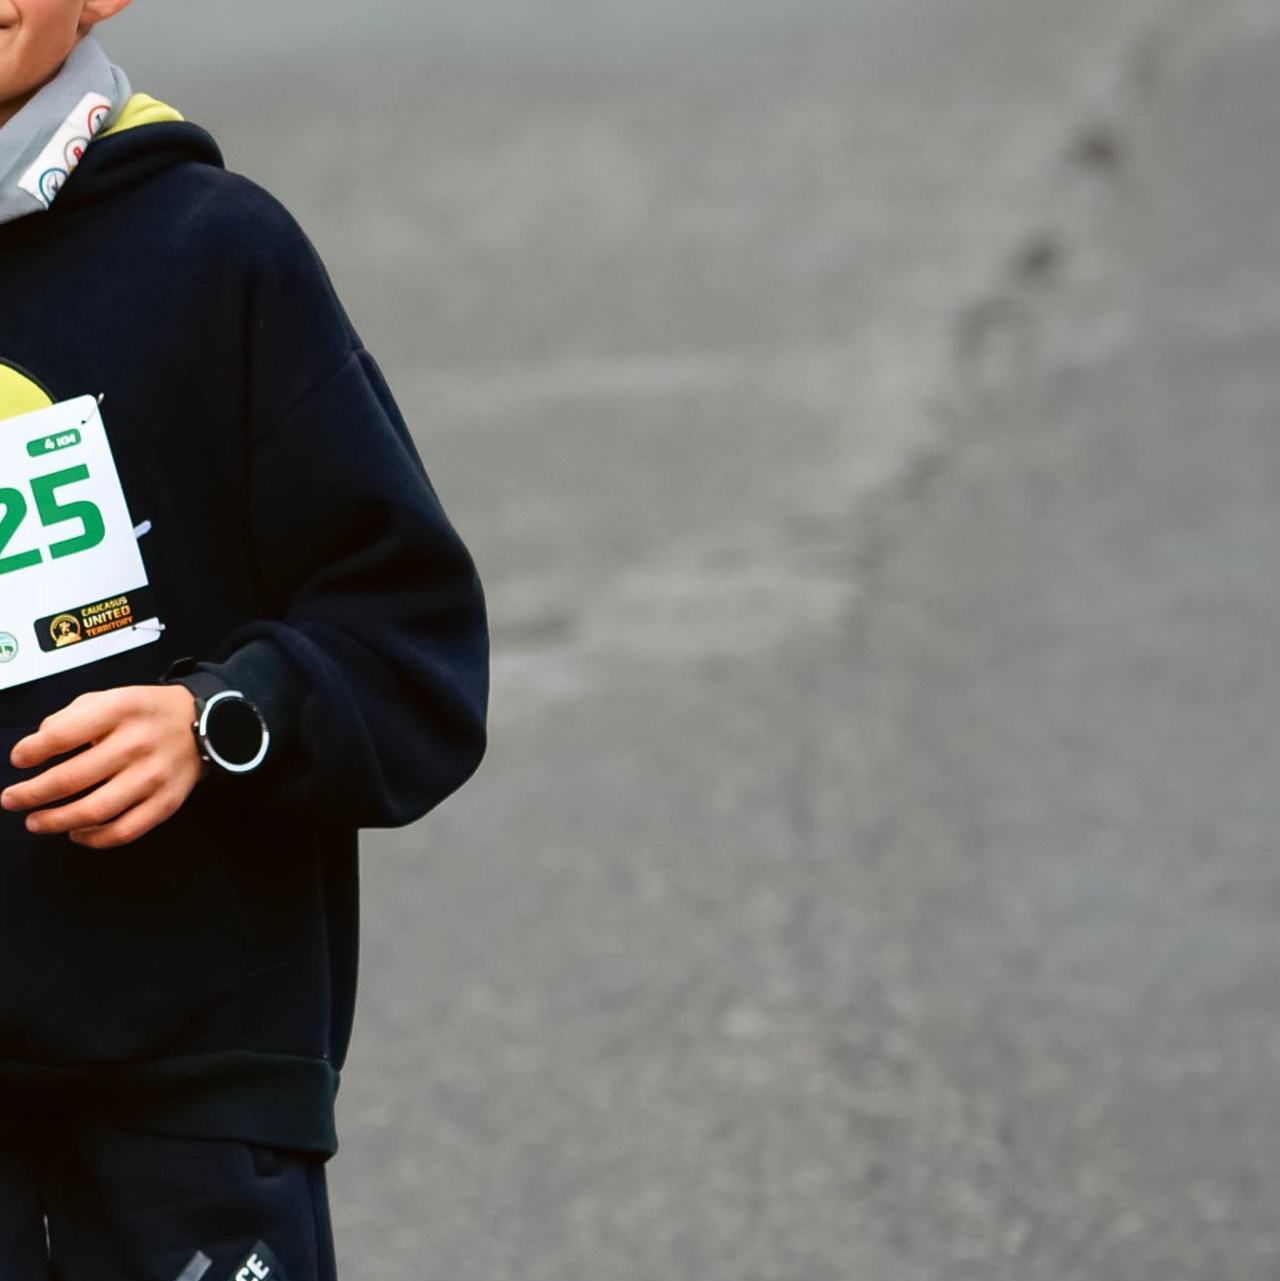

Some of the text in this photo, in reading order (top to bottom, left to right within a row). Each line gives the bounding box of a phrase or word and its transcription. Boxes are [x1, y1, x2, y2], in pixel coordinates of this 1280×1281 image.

[44, 437, 55, 450] 4
[80, 595, 128, 617] CAUCASUS
[82, 604, 131, 629] UNITED
[85, 615, 134, 637] TERRITORY
